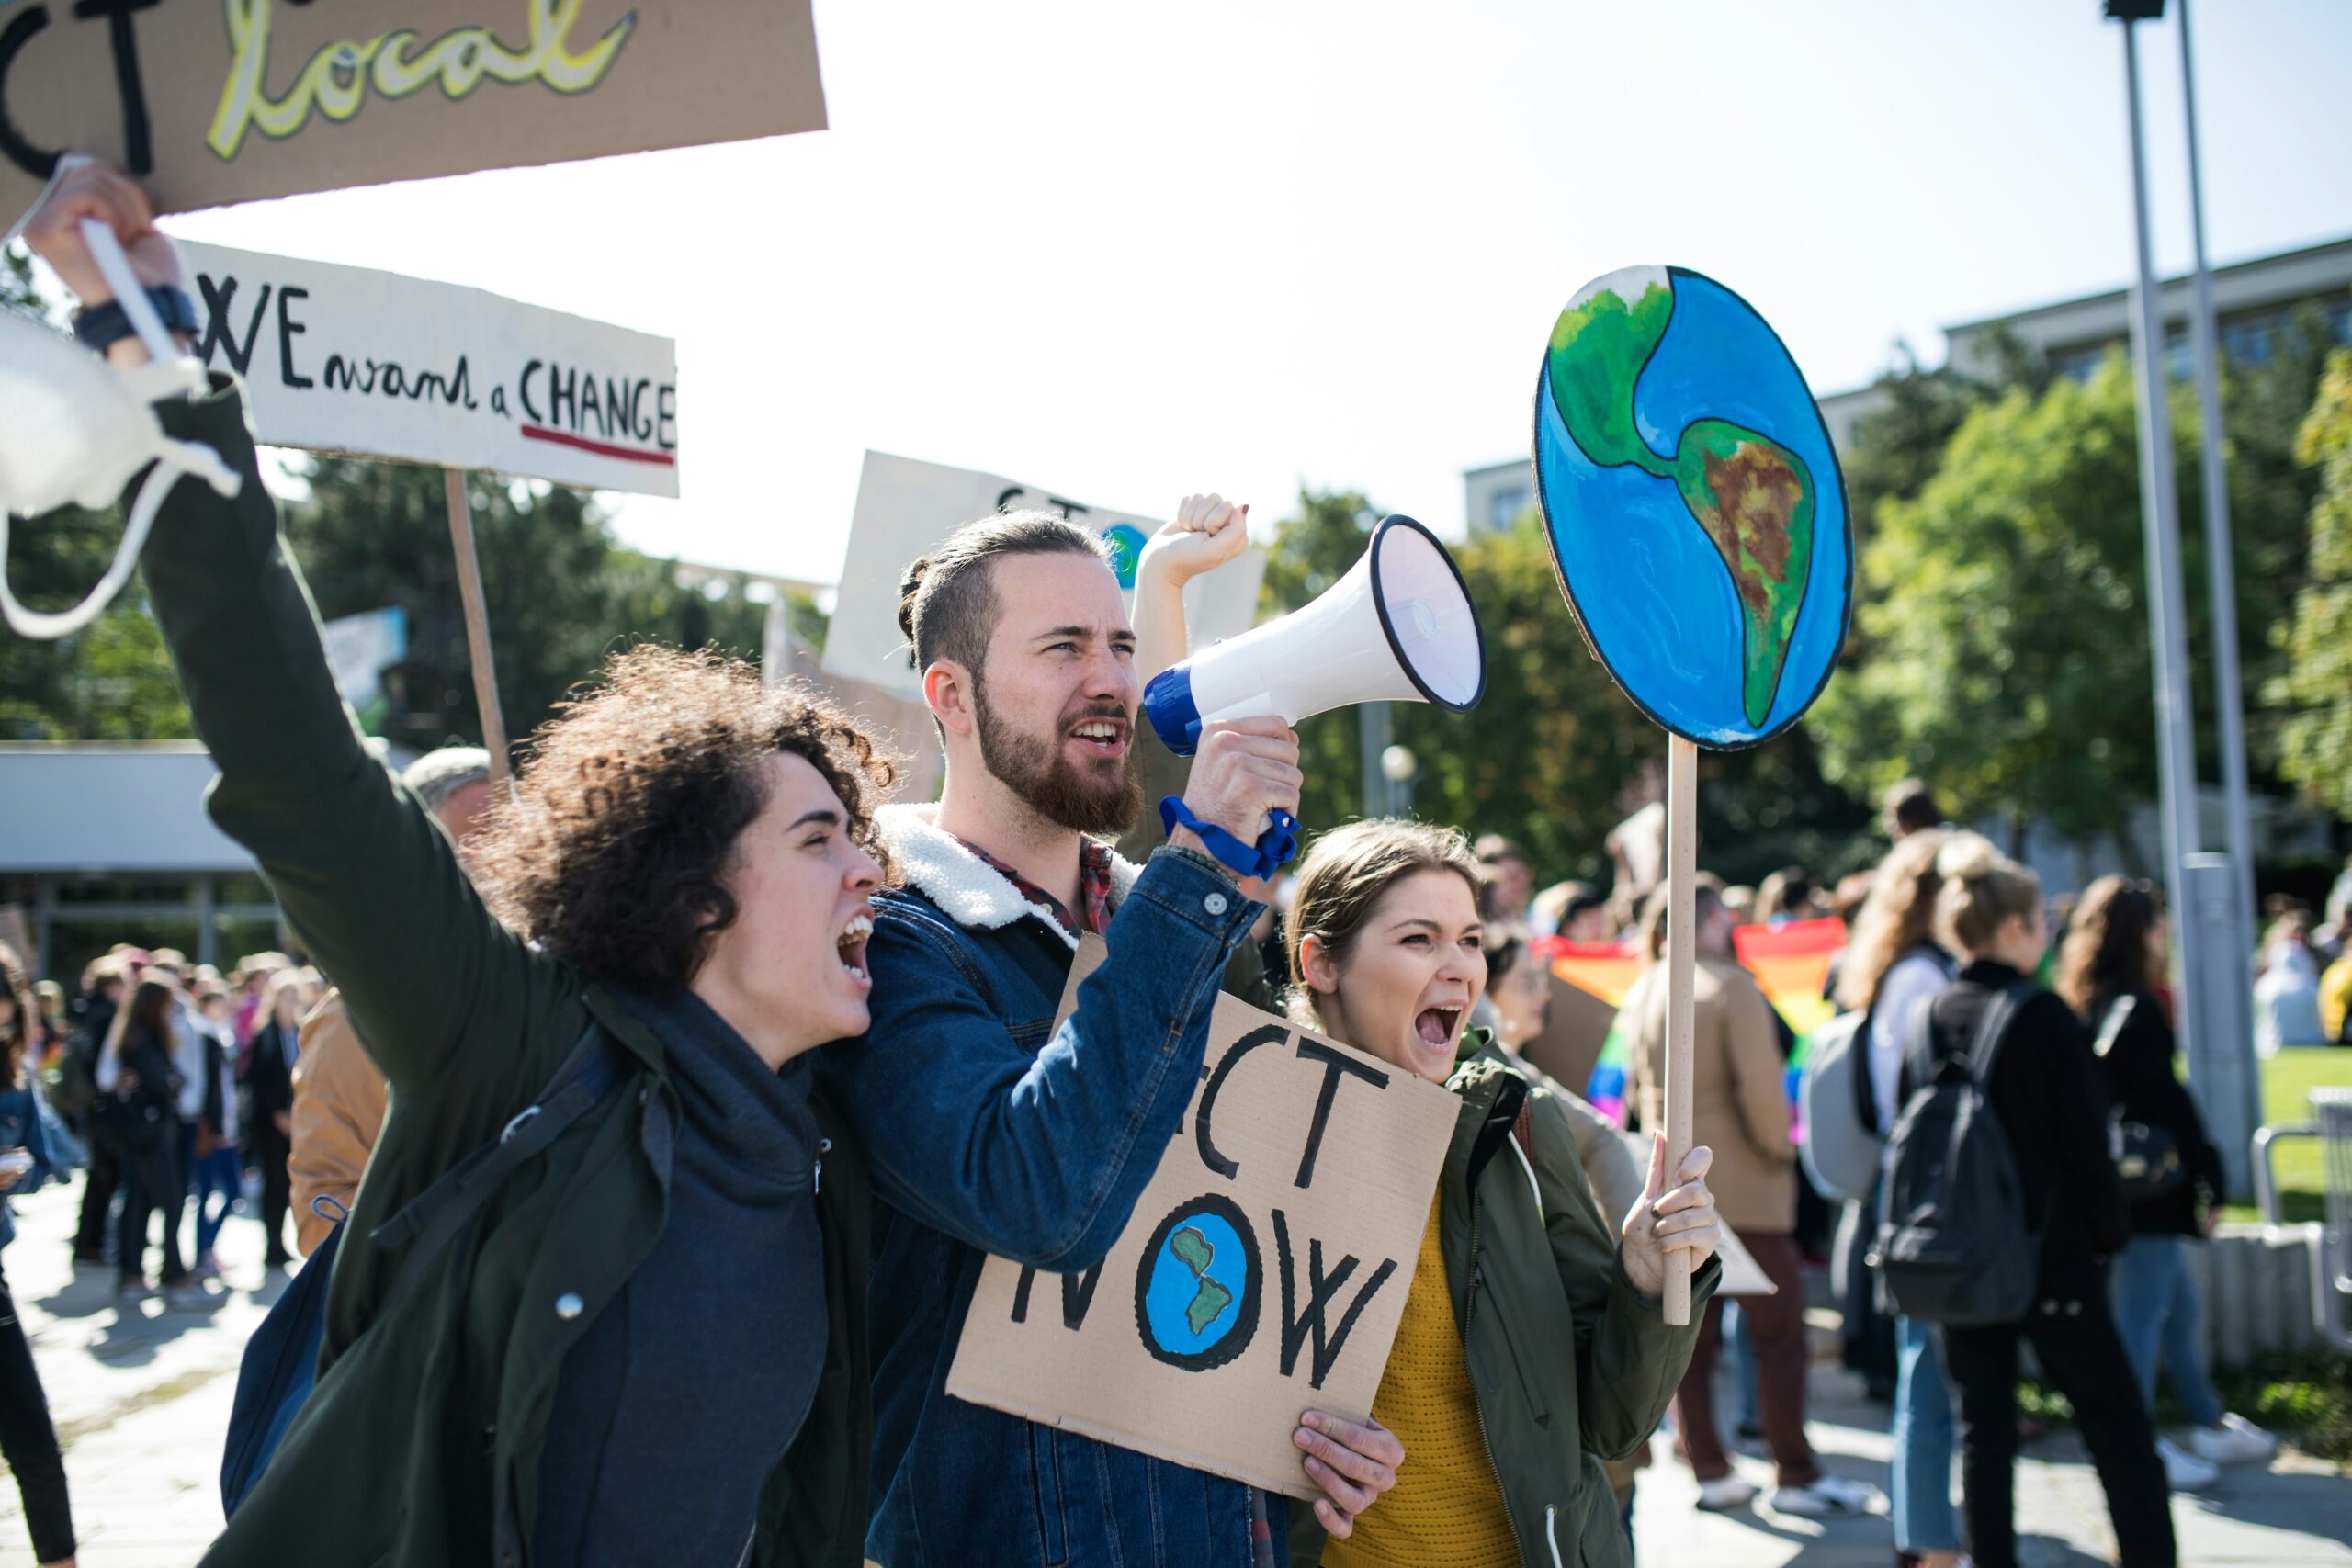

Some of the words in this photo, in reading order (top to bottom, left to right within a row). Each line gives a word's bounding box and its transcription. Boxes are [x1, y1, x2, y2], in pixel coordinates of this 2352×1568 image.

[205, 0, 638, 163] local
[189, 272, 314, 389] WE
[323, 353, 478, 411] want
[491, 385, 512, 420] a
[518, 357, 676, 449] CHANGE
[1175, 1023, 1390, 1189] CT
